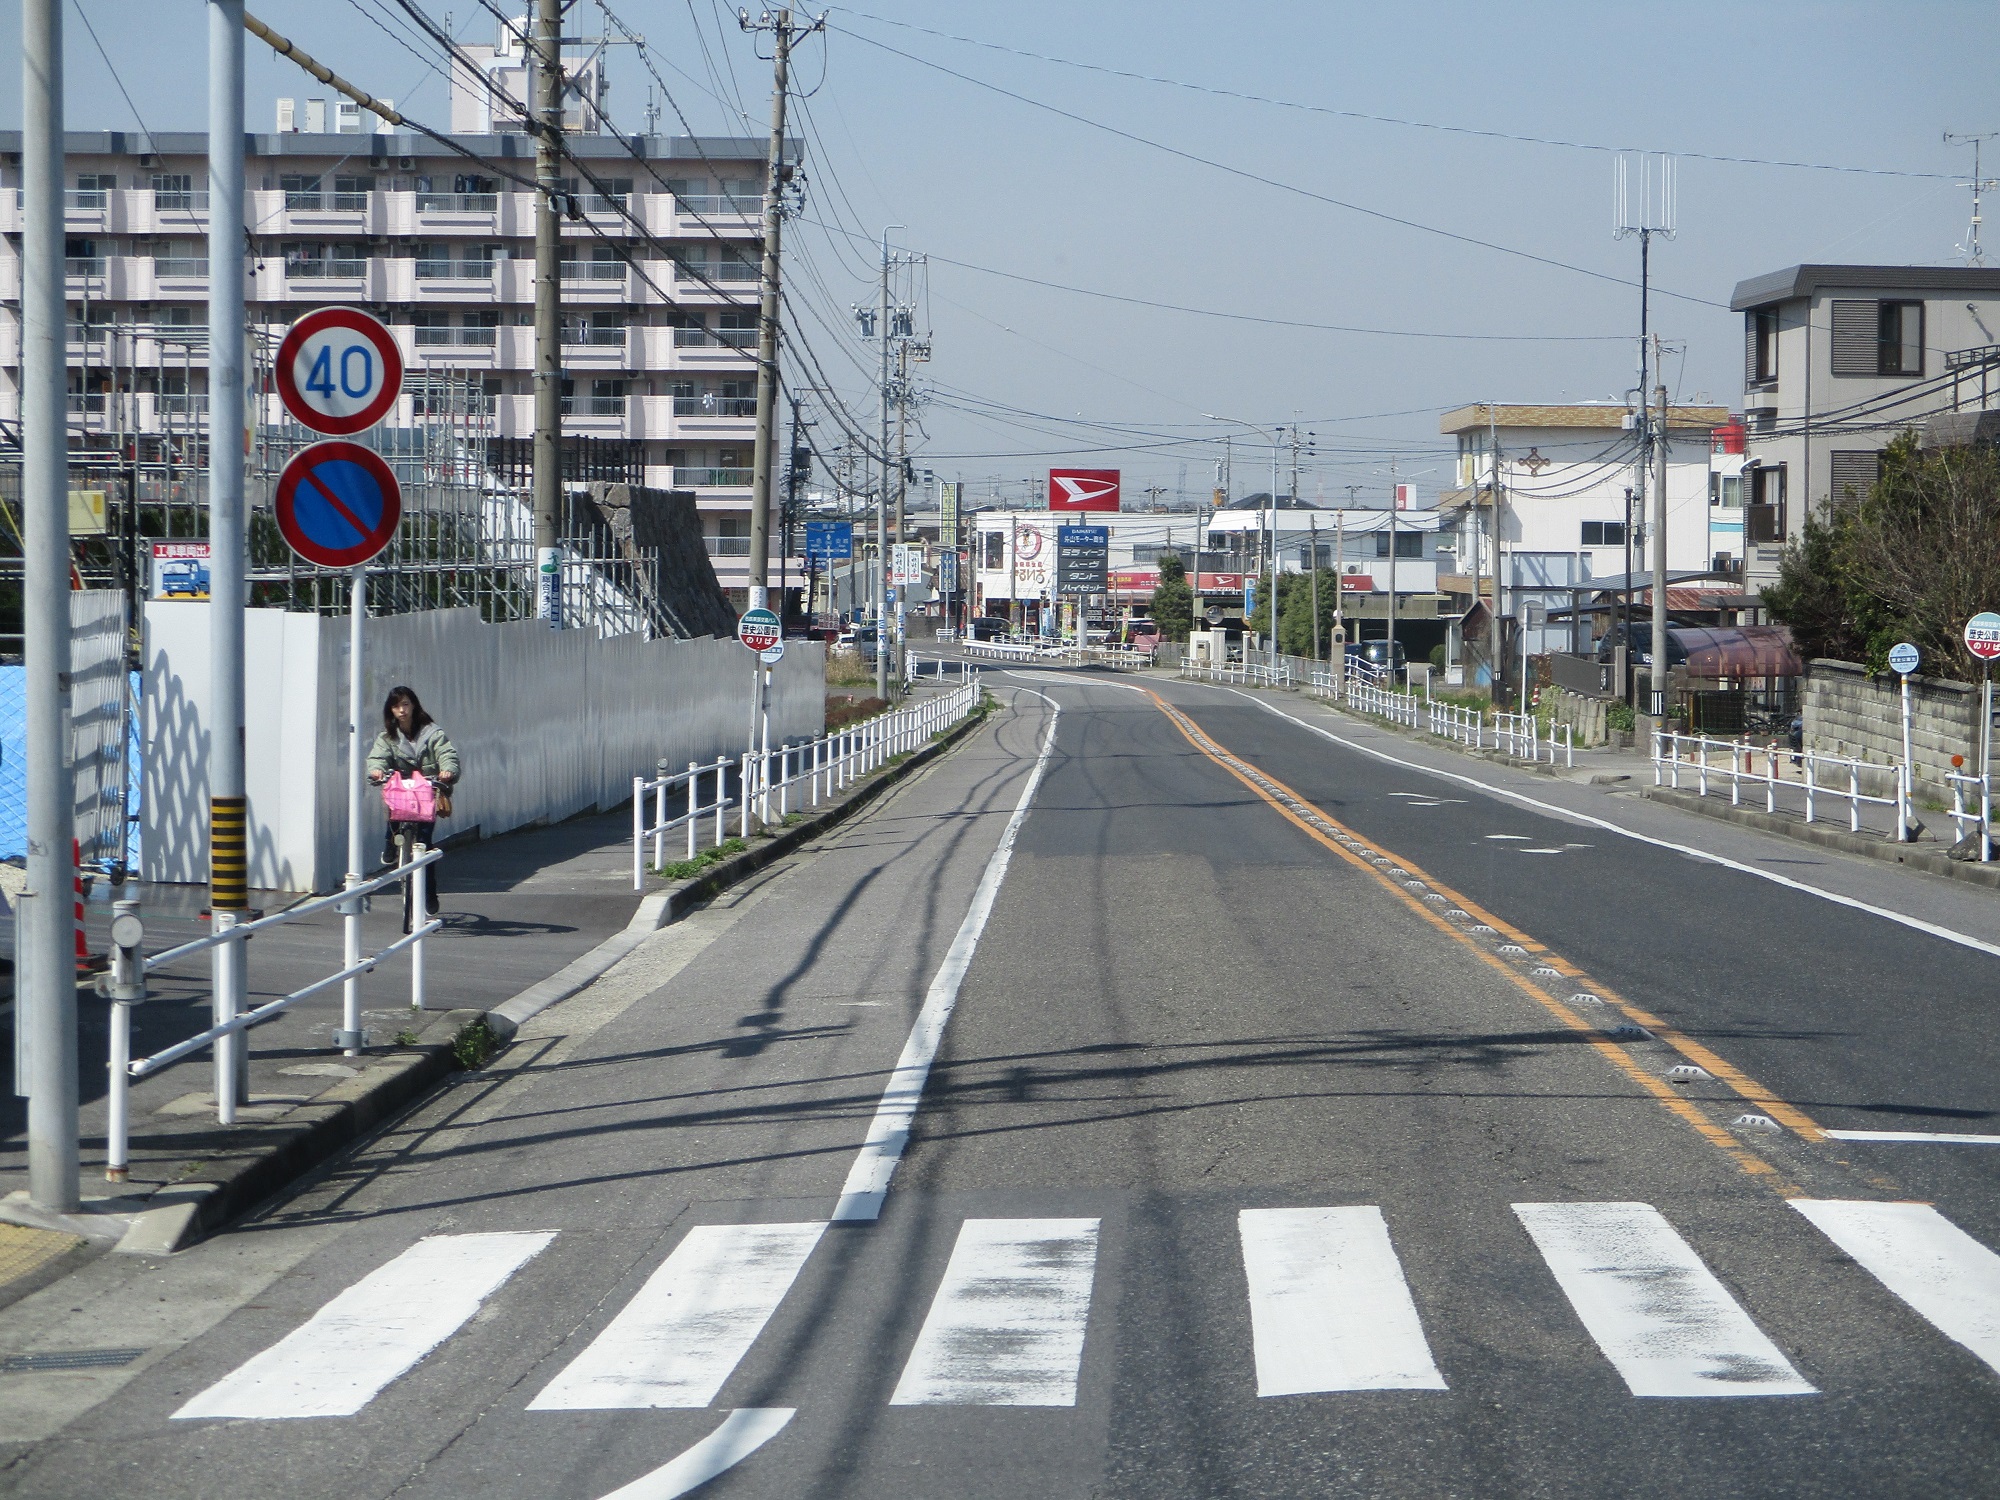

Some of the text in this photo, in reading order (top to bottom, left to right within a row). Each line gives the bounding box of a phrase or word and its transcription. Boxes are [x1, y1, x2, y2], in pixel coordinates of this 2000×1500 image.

[306, 345, 372, 398] 40
[1069, 572, 1099, 580] タント
[1061, 584, 1105, 592] ハイゼット
[742, 625, 778, 636] 歴史公園前
[1969, 629, 2000, 640] 歴史公園
[746, 637, 773, 645] のりば
